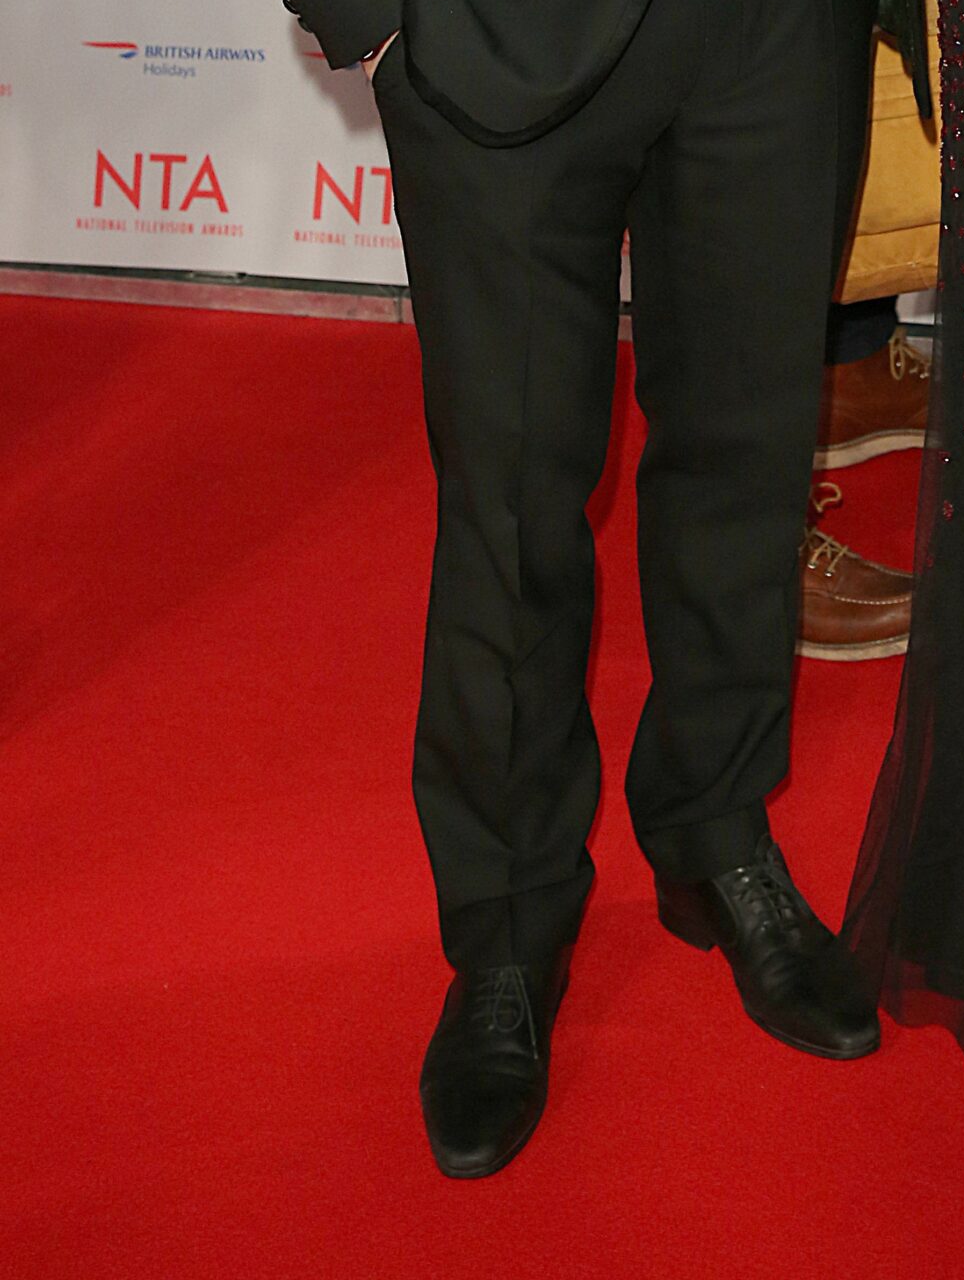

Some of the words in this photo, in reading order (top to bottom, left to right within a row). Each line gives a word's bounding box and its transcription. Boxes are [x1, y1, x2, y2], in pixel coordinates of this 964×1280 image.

[145, 45, 200, 59] BRITISH
[205, 48, 265, 62] AIRWAYS
[143, 64, 196, 78] Holidays
[94, 149, 229, 213] NTA
[313, 160, 393, 225] NT
[76, 217, 127, 232] NATIONAL
[134, 219, 194, 234] TELEVISION
[202, 222, 243, 237] AWARDS
[294, 229, 346, 246] NATIONAL
